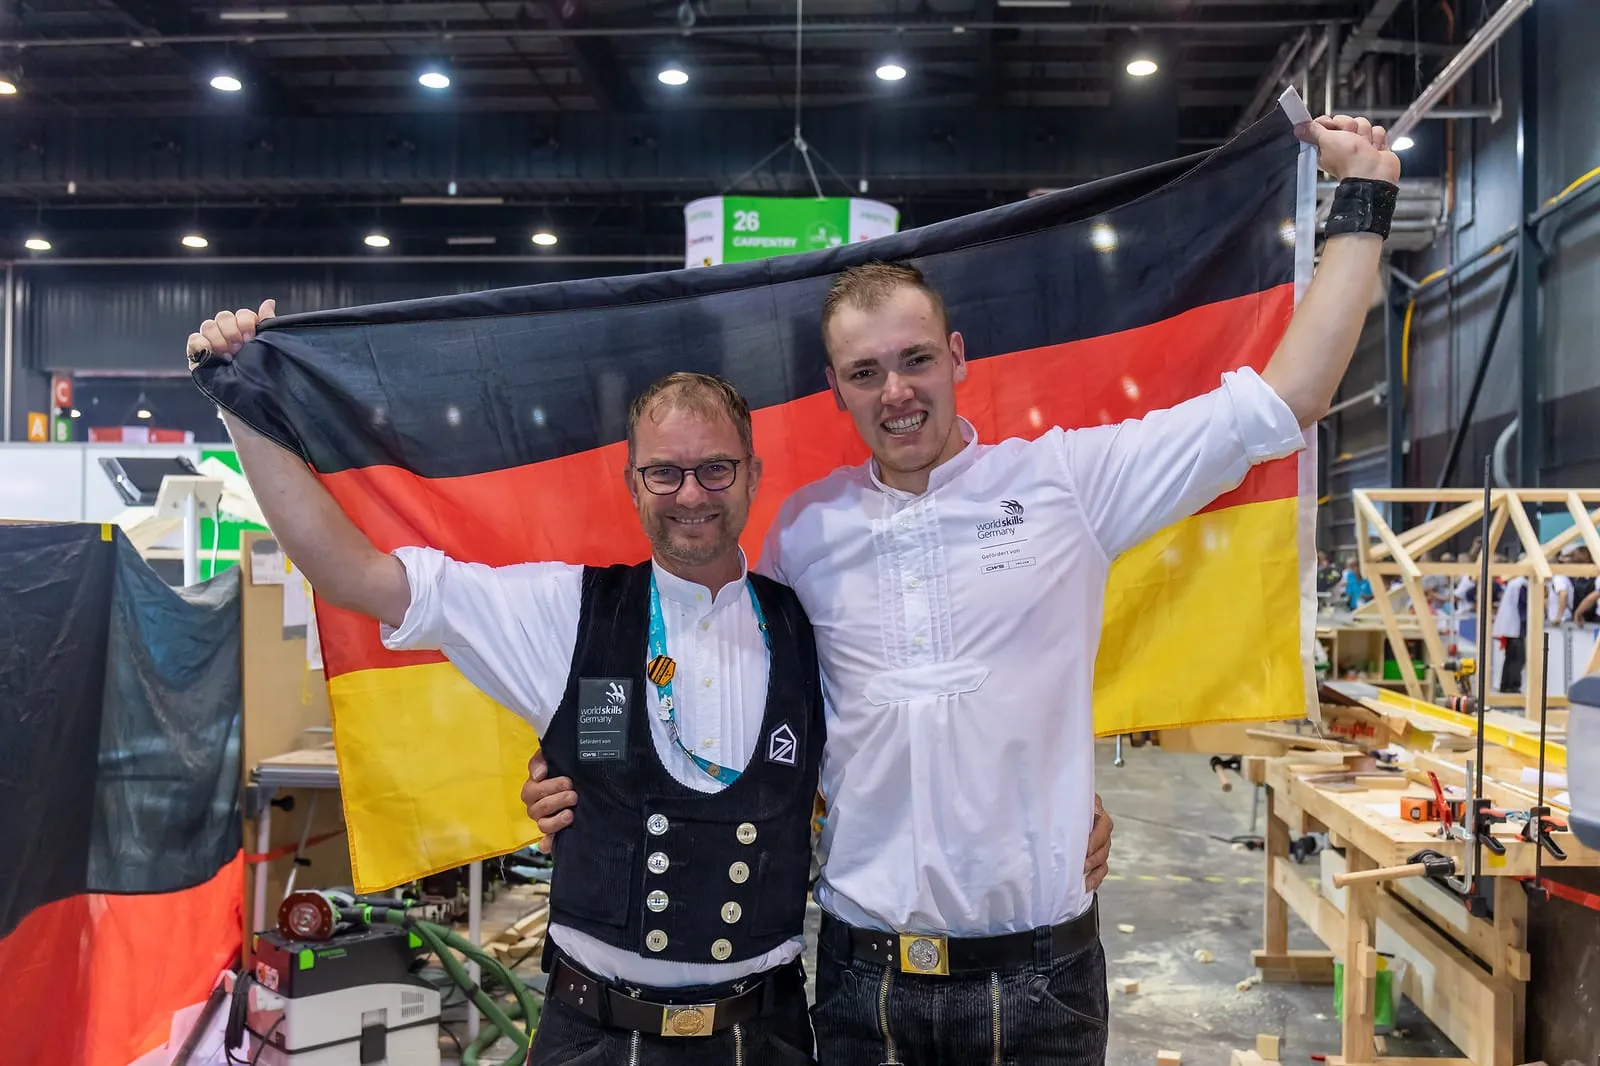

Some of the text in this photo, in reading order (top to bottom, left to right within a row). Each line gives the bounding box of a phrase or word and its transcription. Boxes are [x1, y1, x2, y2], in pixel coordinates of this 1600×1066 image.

[733, 210, 760, 231] 26
[732, 236, 798, 248] CARPENTRY
[56, 382, 68, 402] C
[31, 418, 44, 438] A
[56, 421, 67, 441] B
[976, 515, 1024, 530] worldskills
[977, 527, 1016, 540] Germany
[581, 705, 623, 715] worldskills
[580, 714, 613, 725] Germany
